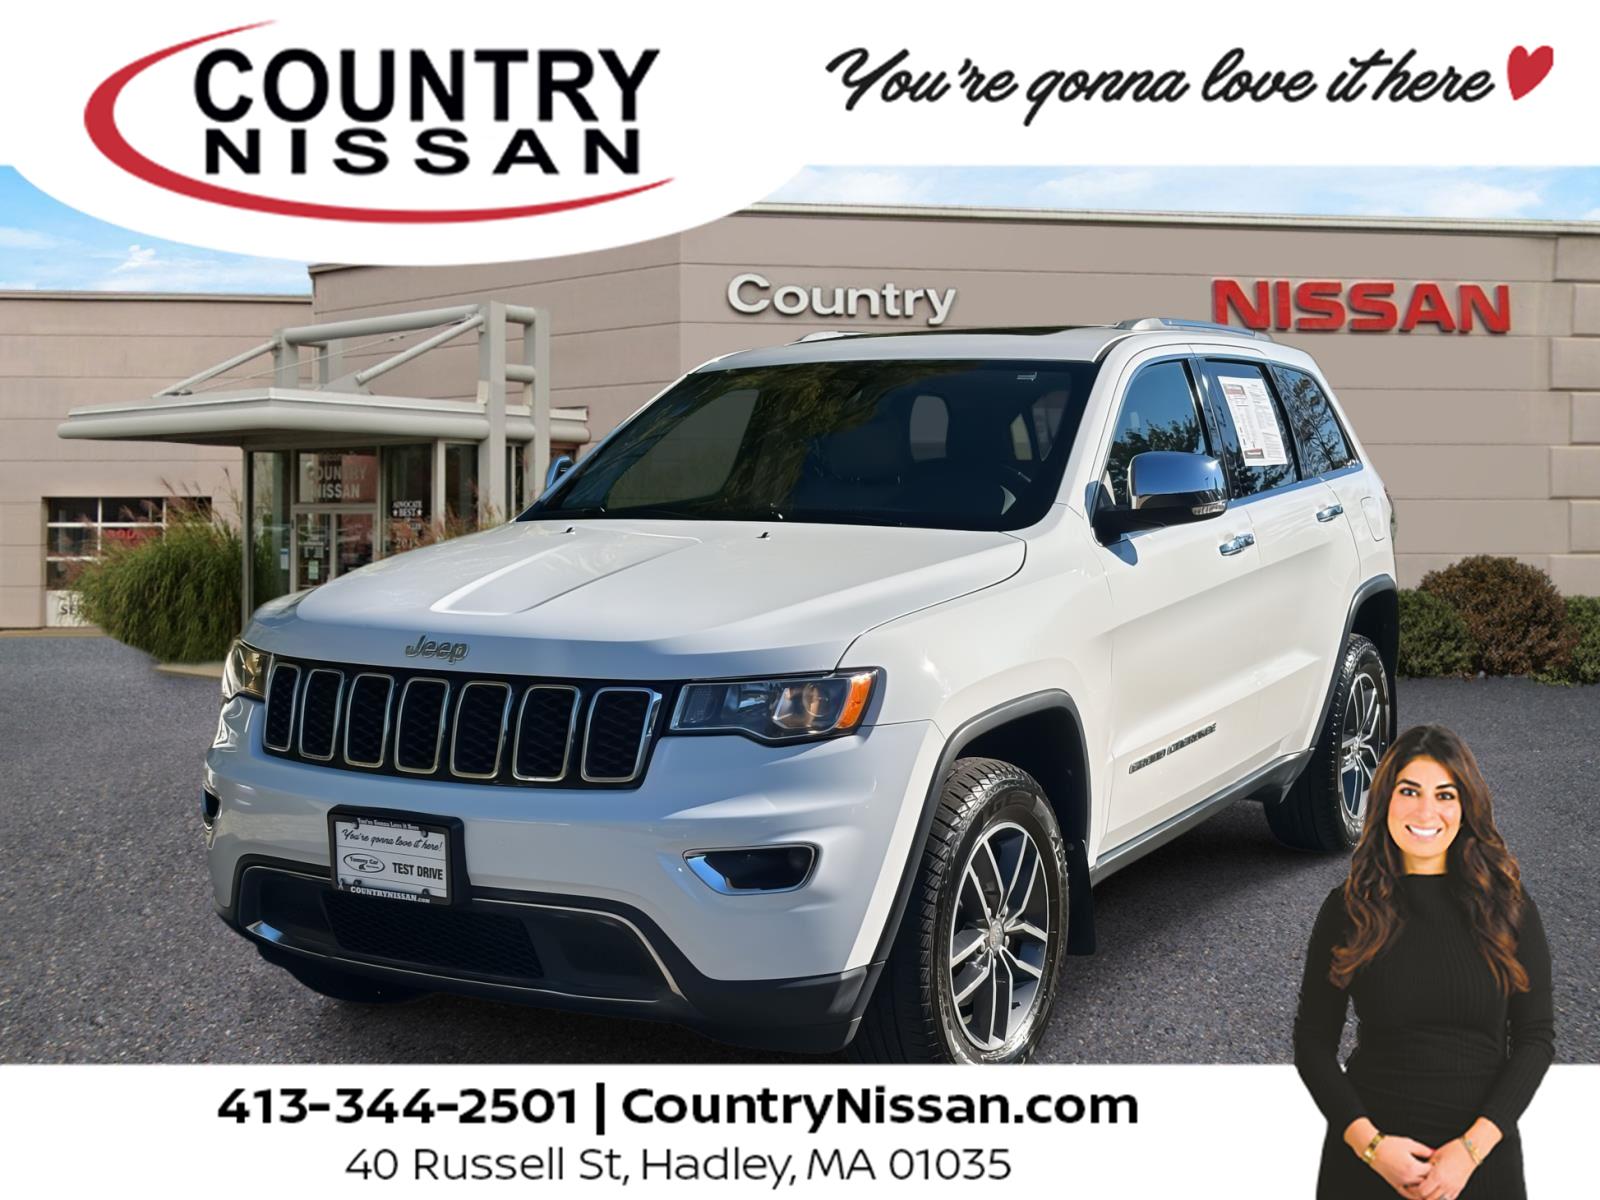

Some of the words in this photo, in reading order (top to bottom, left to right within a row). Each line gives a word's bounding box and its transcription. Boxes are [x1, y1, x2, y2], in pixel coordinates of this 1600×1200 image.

[727, 273, 956, 327] Country
[1213, 278, 1511, 334] NISSAN
[405, 634, 468, 664] Jeep
[342, 828, 369, 841] You're
[371, 836, 394, 847] gonna
[395, 836, 412, 848] love
[392, 862, 414, 876] TEST
[417, 866, 443, 880] DRIVE
